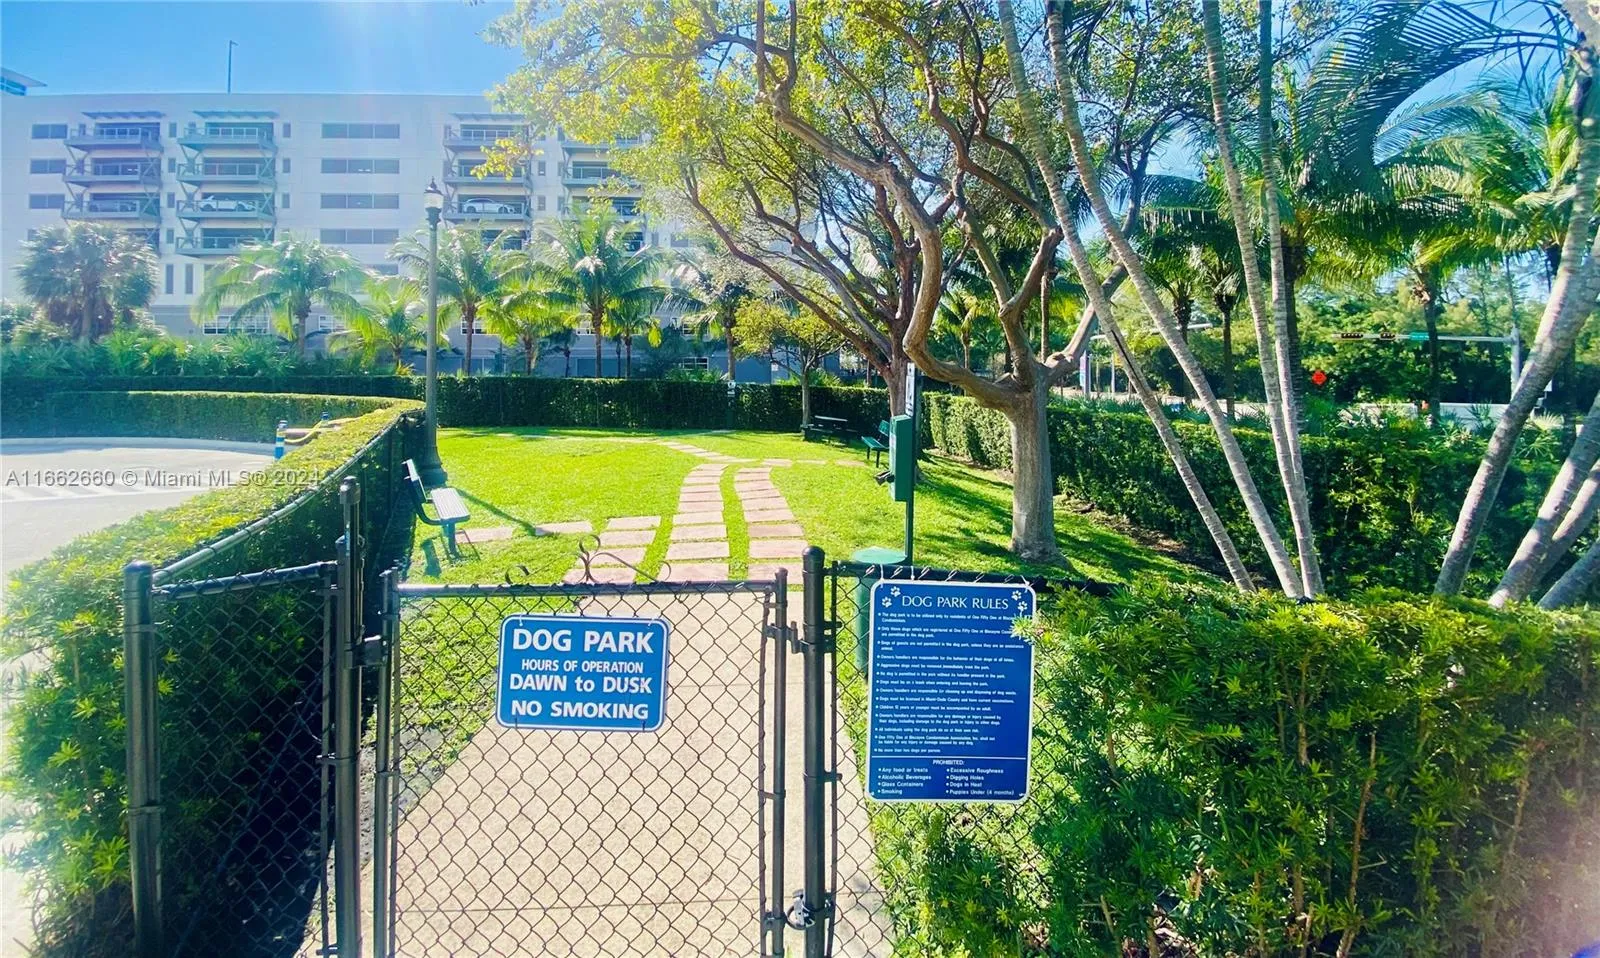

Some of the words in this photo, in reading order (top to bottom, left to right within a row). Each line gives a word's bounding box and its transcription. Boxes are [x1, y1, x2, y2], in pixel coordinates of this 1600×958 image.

[902, 596, 932, 607] DOG
[937, 597, 968, 608] PARK
[972, 598, 1009, 609] RULES
[513, 628, 572, 651] DOG
[584, 631, 653, 653] PARK
[522, 659, 559, 671] HOURS
[564, 660, 578, 672] OF
[582, 661, 643, 673] OPERATION
[510, 674, 567, 691] DAWN
[575, 676, 595, 692] to
[603, 677, 652, 694] DUSK
[511, 700, 542, 716] NO
[551, 702, 648, 719] SMOKING
